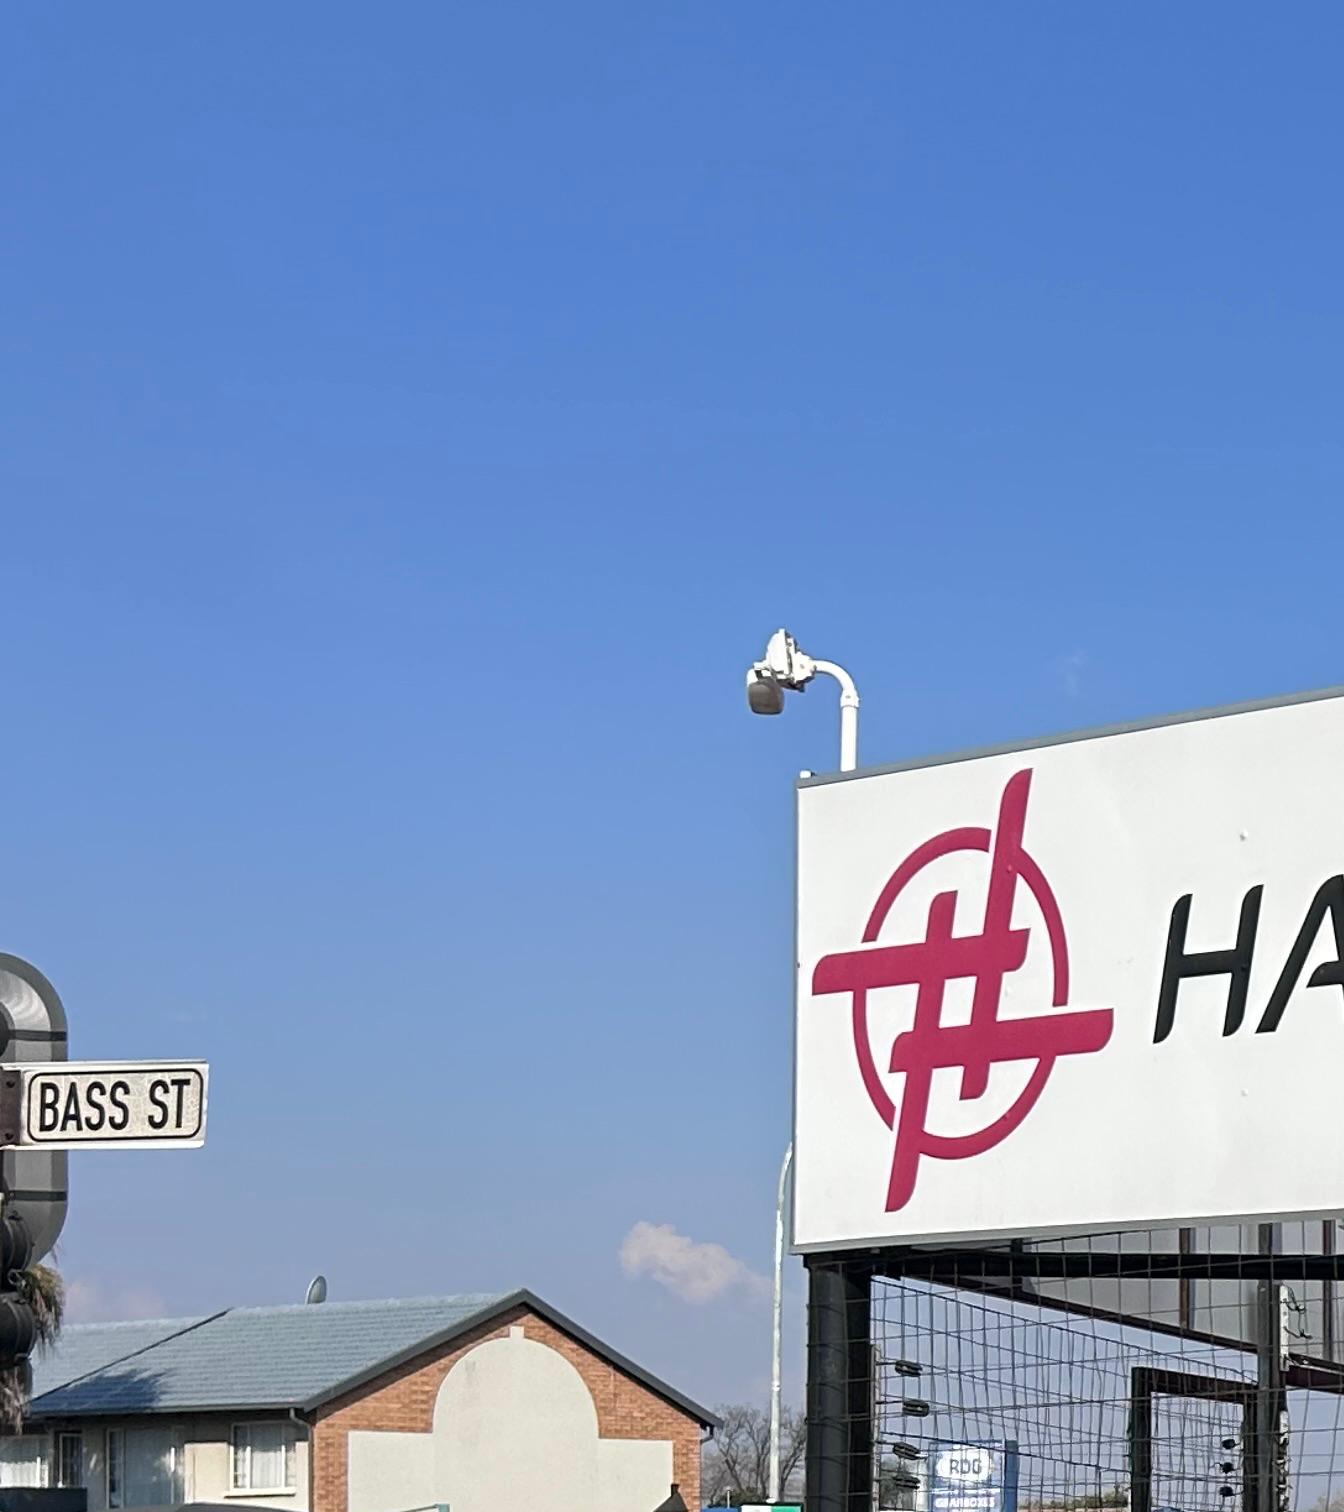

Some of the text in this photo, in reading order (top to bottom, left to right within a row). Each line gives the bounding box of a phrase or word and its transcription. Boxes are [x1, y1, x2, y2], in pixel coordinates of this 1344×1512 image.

[39, 1078, 191, 1132] BASS ST
[949, 1459, 982, 1474] RDG
